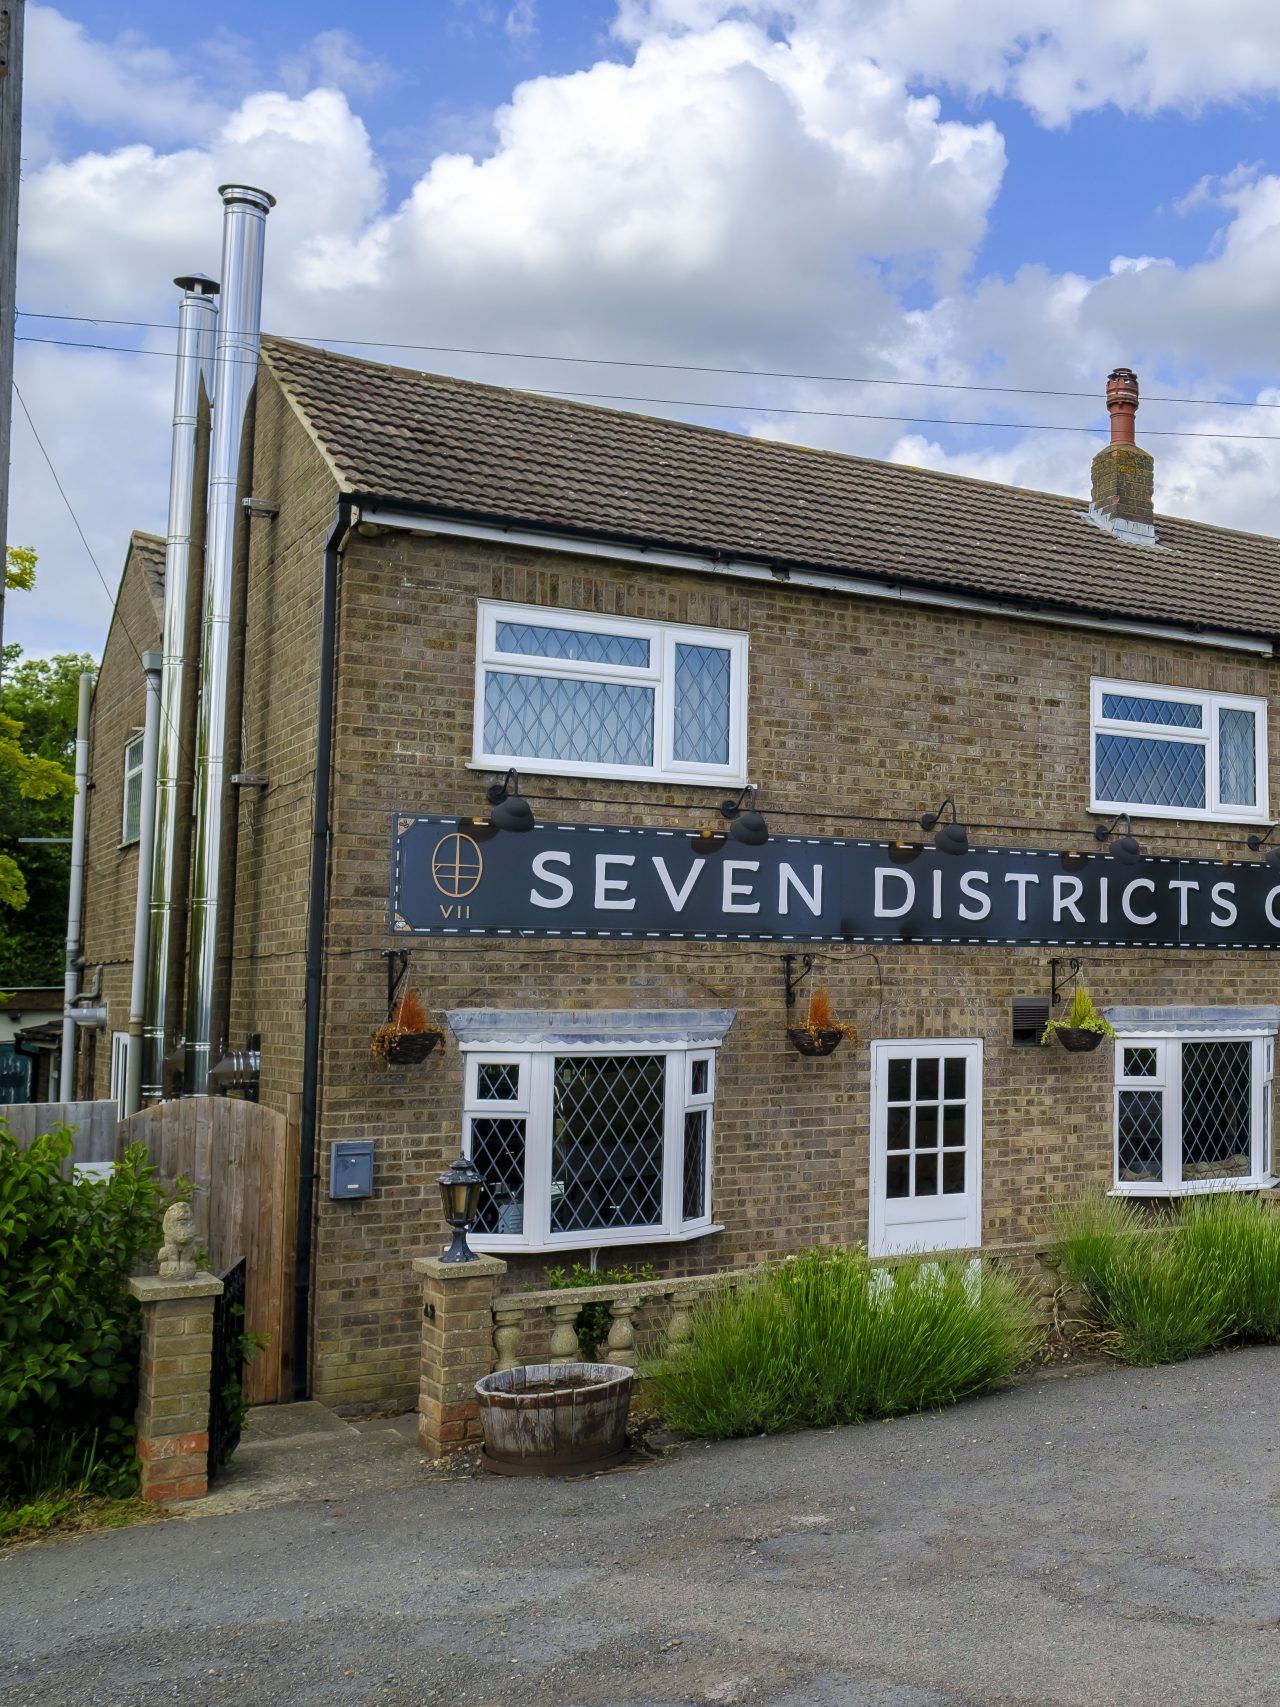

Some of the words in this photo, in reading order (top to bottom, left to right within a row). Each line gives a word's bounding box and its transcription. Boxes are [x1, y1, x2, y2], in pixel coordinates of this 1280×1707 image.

[439, 904, 471, 919] VII
[529, 850, 823, 917] SEVEN
[873, 866, 1238, 927] DISTRICTS
